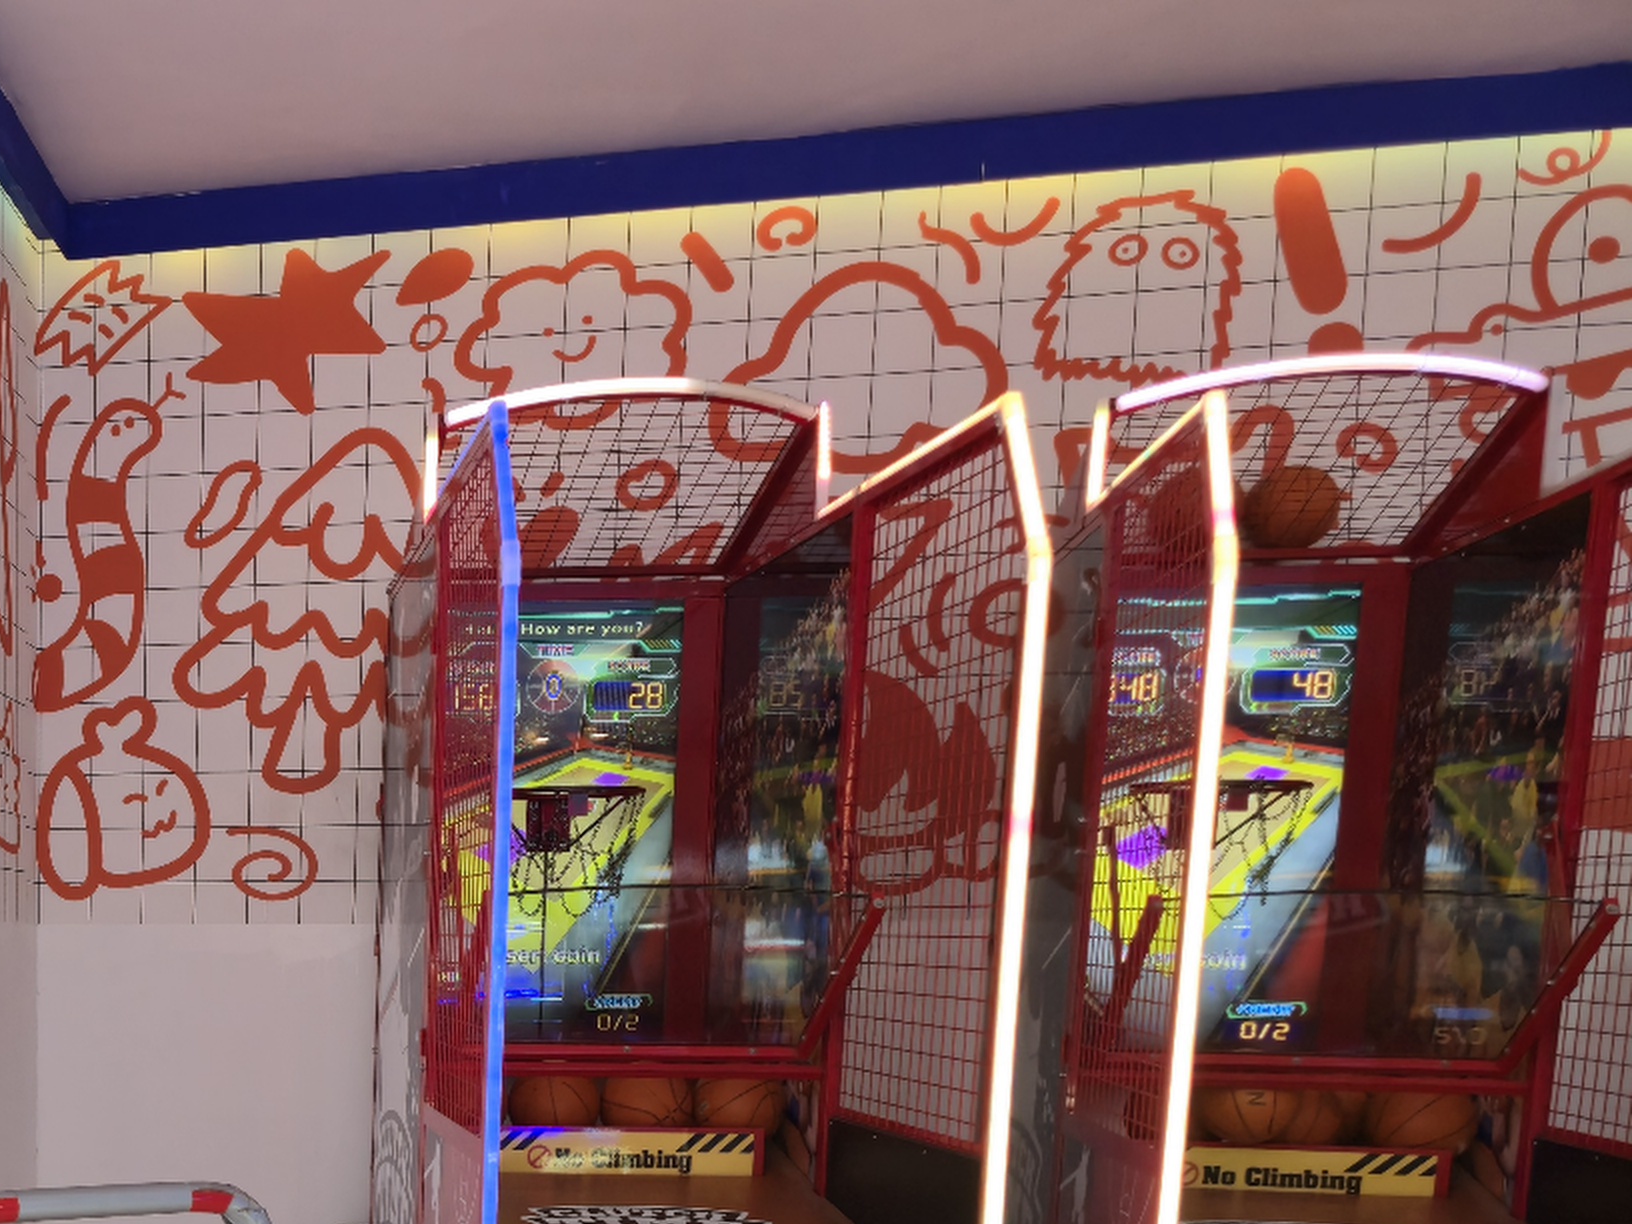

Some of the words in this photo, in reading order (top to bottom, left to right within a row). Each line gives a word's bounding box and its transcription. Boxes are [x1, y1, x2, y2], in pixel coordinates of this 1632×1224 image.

[521, 623, 560, 636] How
[566, 625, 596, 636] are
[601, 621, 643, 637] you?
[628, 681, 664, 710] 28
[1293, 671, 1334, 699] 48
[597, 1013, 639, 1031] 0/2
[1239, 1020, 1291, 1041] 0/2
[554, 1147, 585, 1168] No
[591, 1147, 692, 1174] Climbing
[1202, 1165, 1236, 1186] No
[1245, 1167, 1362, 1195] Climbing
